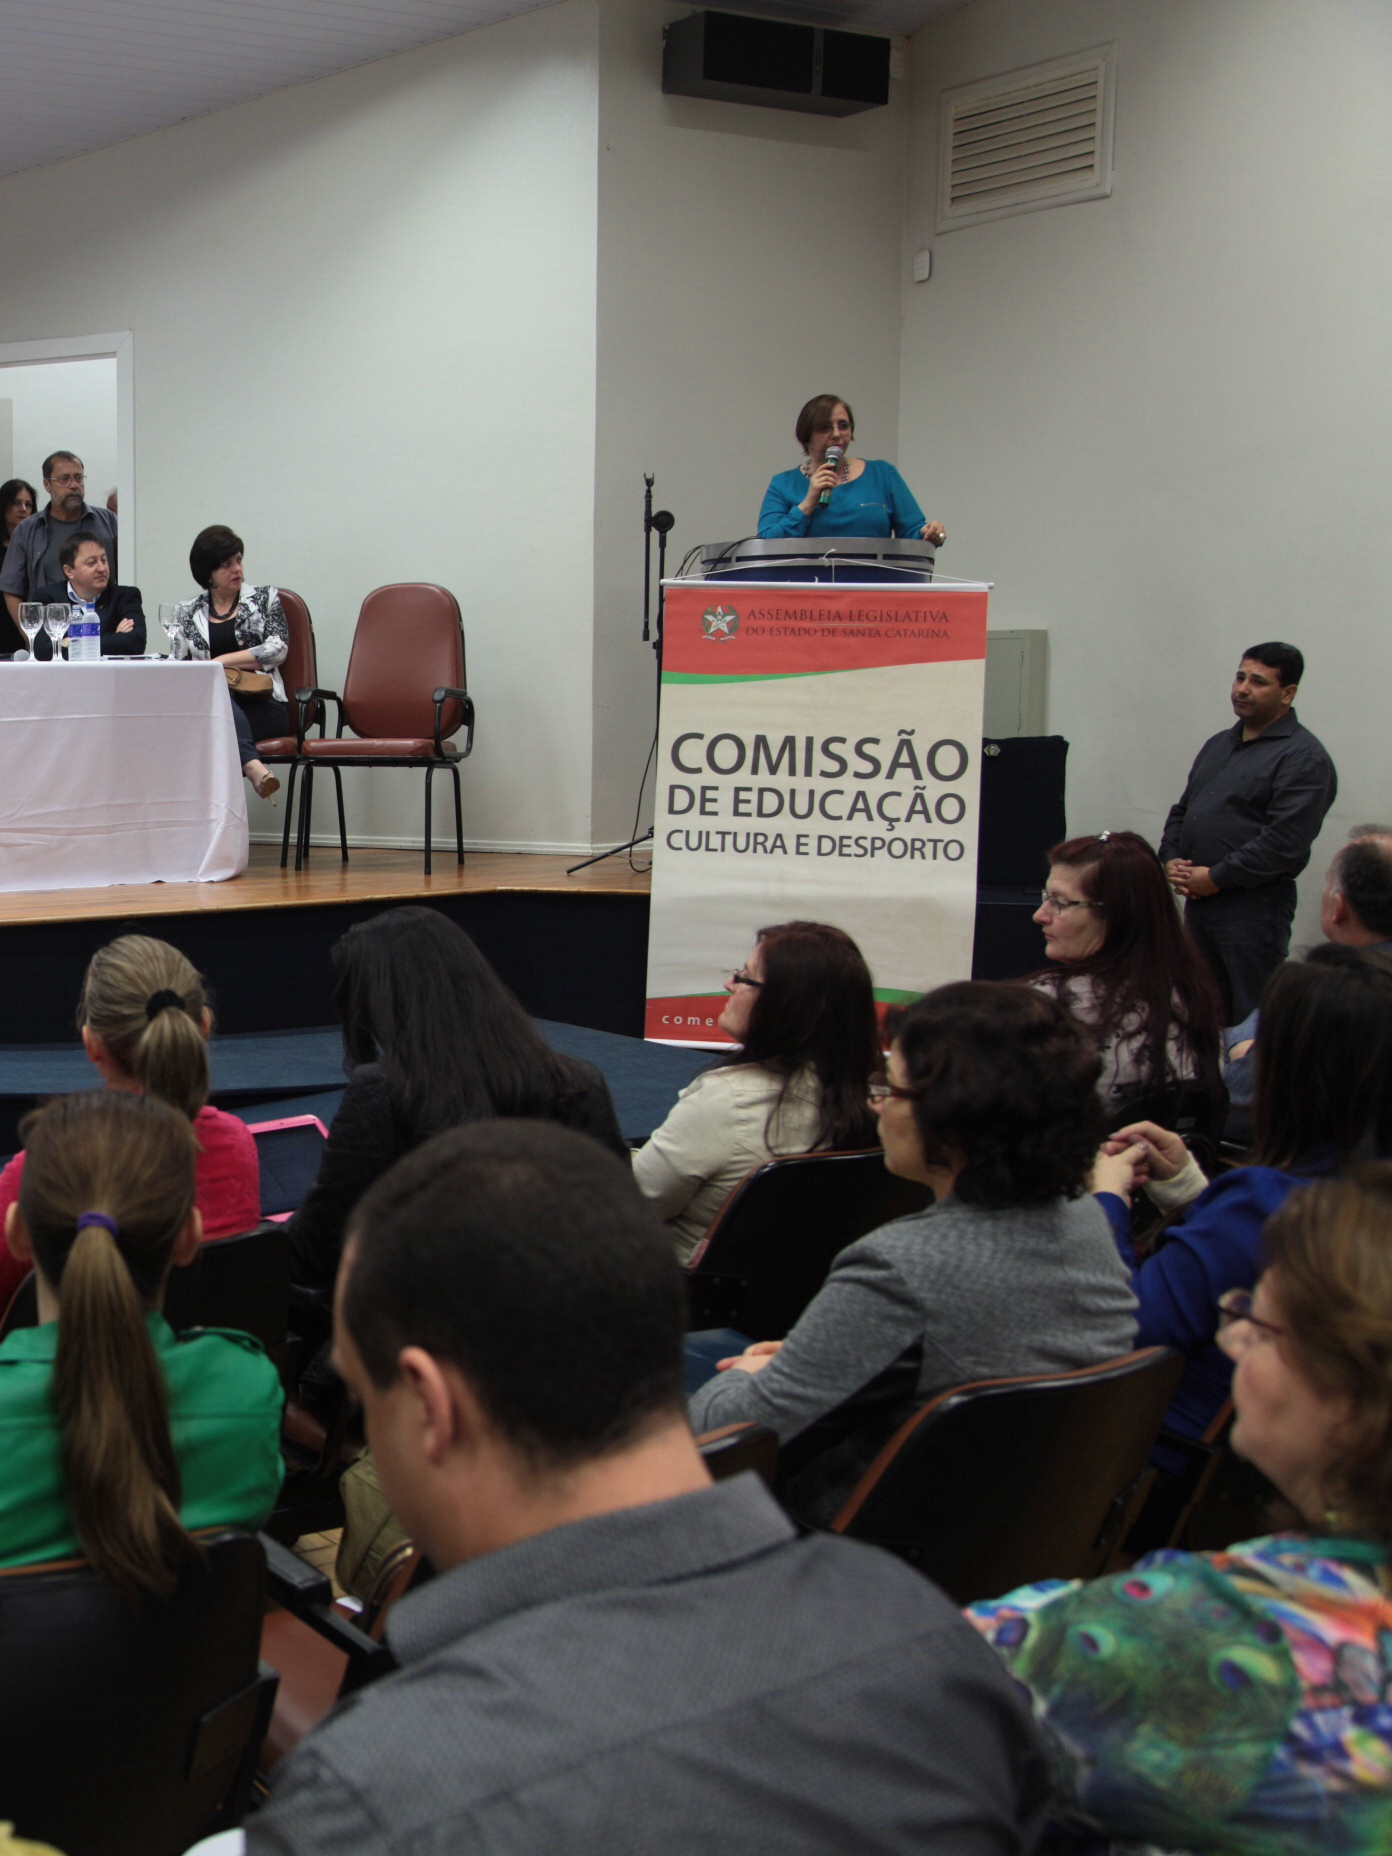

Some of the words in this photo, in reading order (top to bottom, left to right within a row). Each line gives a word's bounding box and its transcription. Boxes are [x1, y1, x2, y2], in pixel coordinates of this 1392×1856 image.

[747, 608, 842, 621] ASSEMBLEIA
[848, 609, 950, 623] LEGISLATIVA
[745, 626, 766, 636] DO
[769, 626, 817, 637] ESTADO
[821, 627, 838, 637] DE
[840, 628, 881, 638] SANTA
[884, 628, 950, 639] CATARINA
[670, 728, 969, 782] COMISSÃO
[667, 784, 720, 817] DE
[732, 785, 967, 831] EDUCAÇÃO
[666, 829, 788, 855] CULTURA
[795, 833, 810, 856] E
[816, 834, 965, 862] DESPORTO
